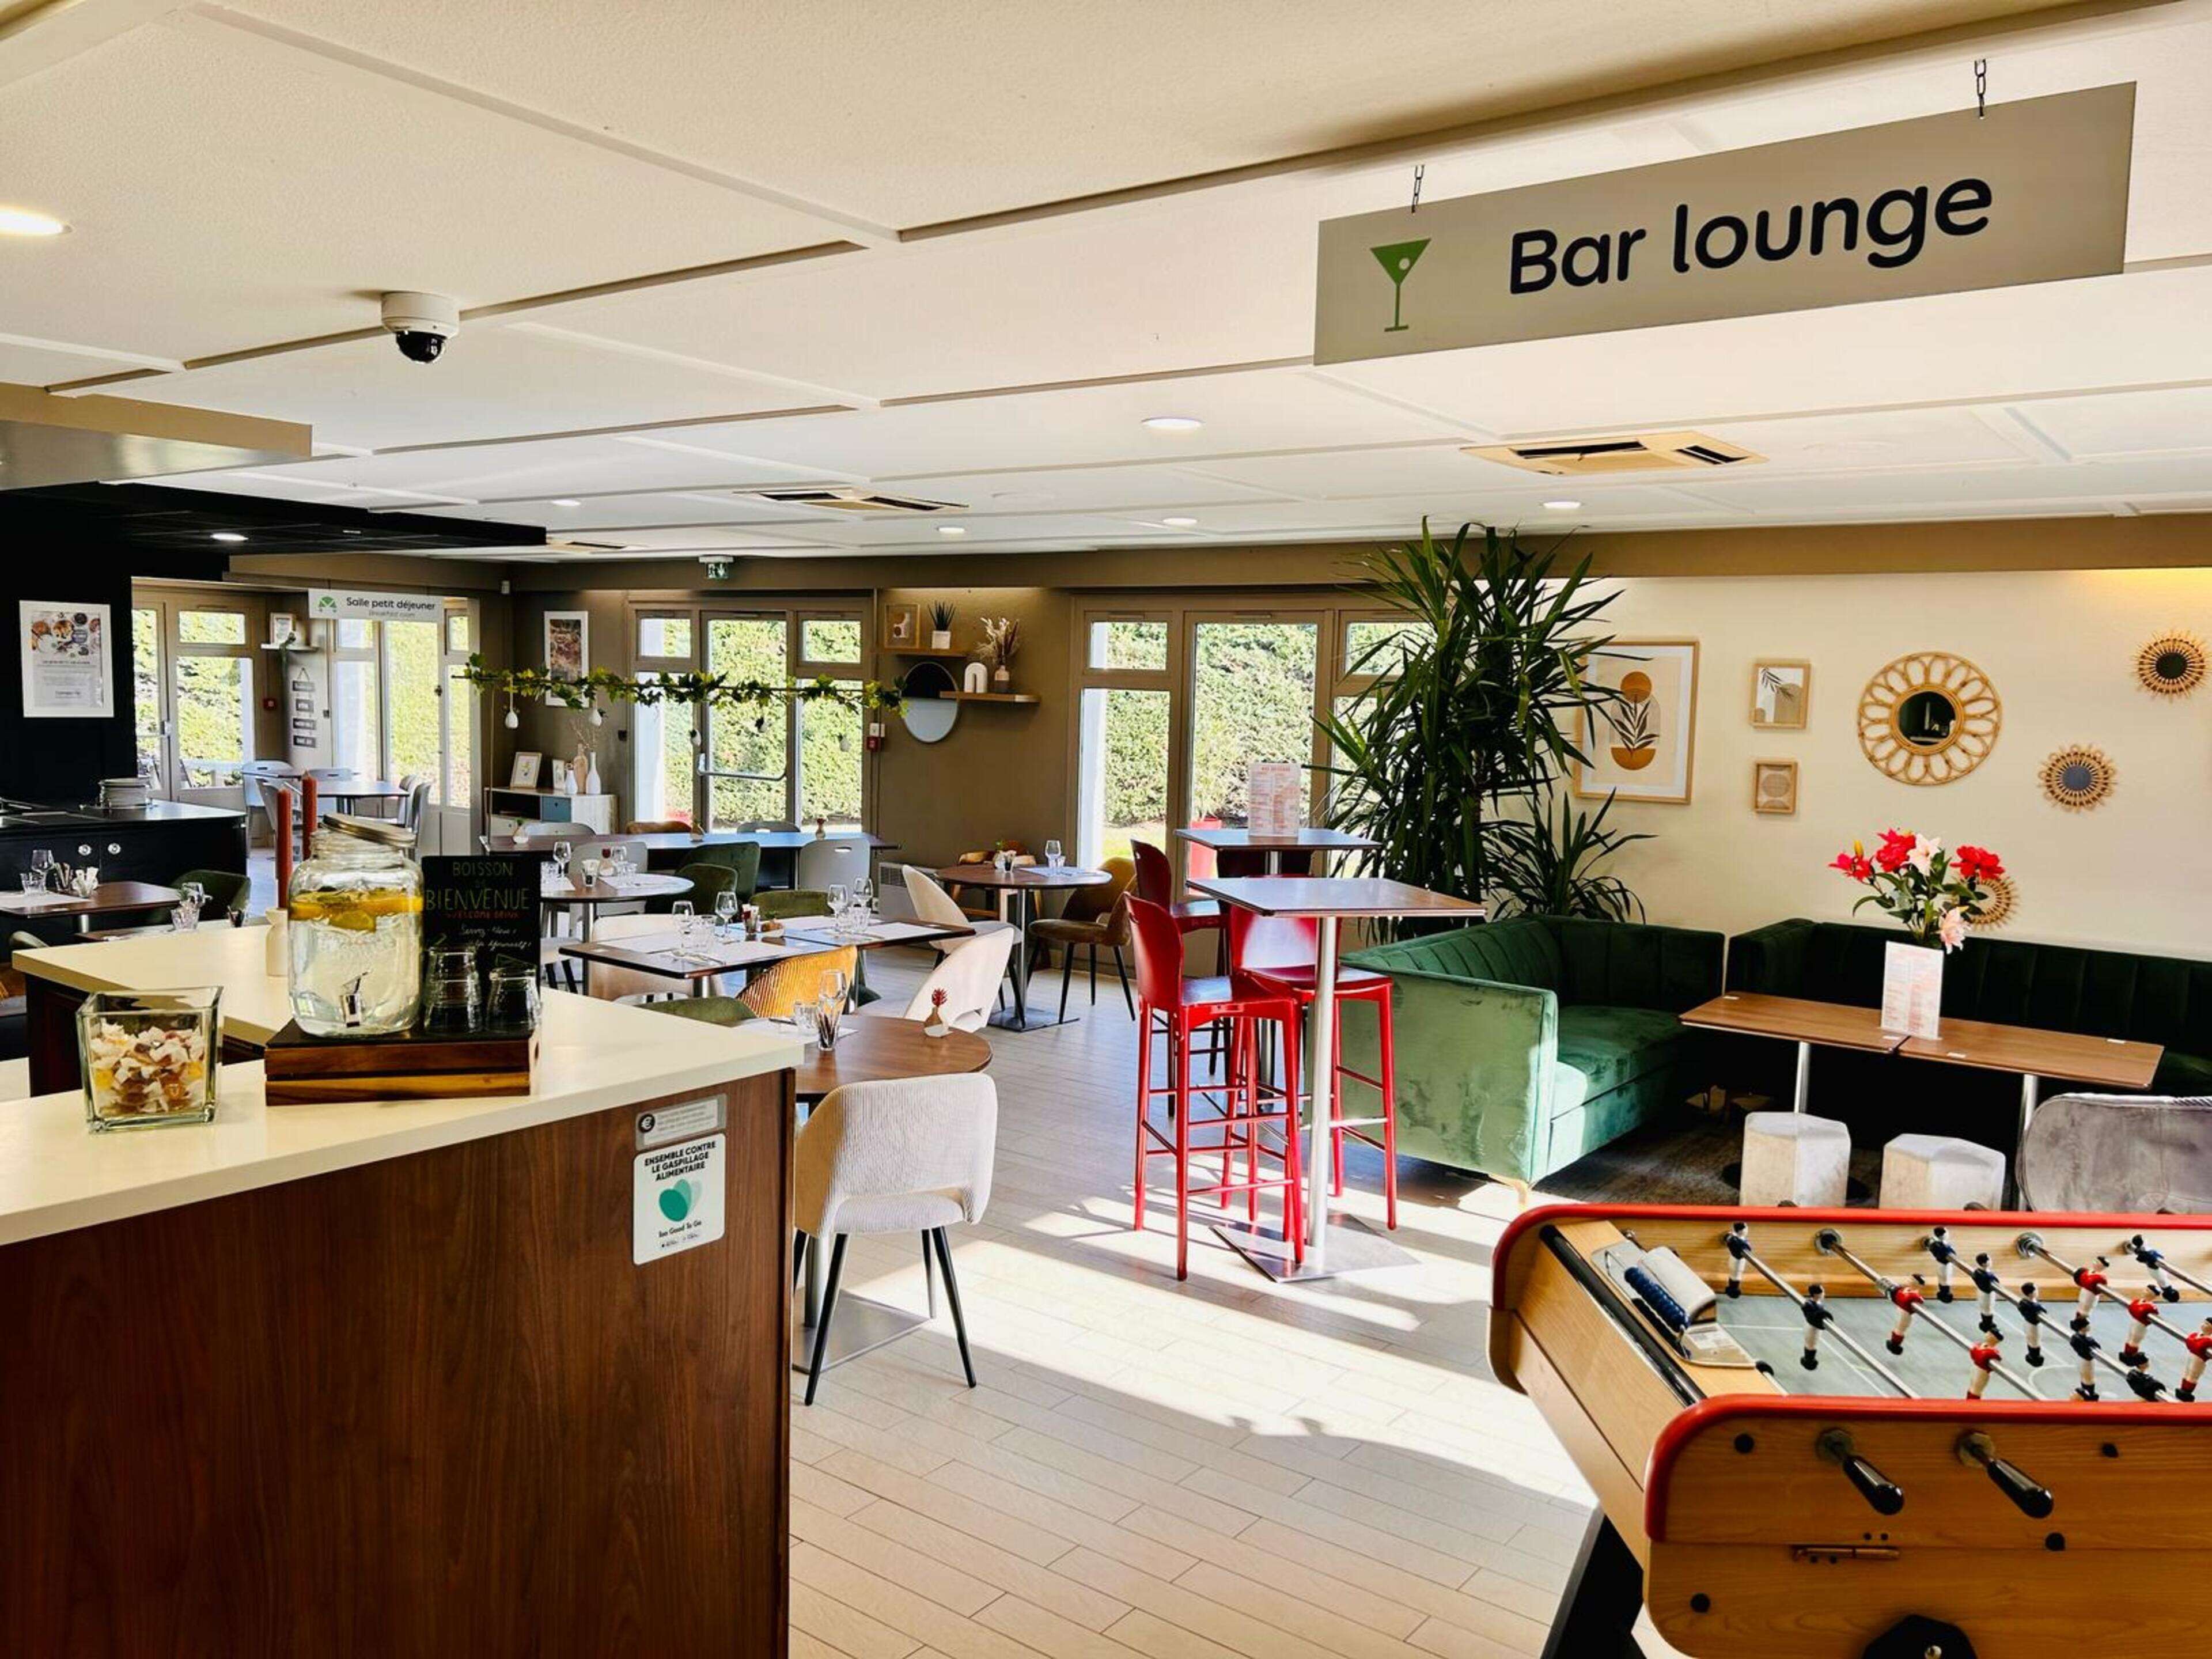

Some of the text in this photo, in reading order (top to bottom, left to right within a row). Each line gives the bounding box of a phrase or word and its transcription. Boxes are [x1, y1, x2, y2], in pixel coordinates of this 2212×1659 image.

[1509, 177, 1993, 295] Bar lounge
[346, 597, 435, 611] Salle petit déjeuner
[452, 862, 513, 876] BOISSON
[426, 888, 531, 911] BIENVENUE
[645, 1141, 716, 1166] ENSEMBLE CONTRE
[652, 1151, 709, 1173] LE GASPILLAGE
[655, 1161, 706, 1181] ALIMENTAIRE
